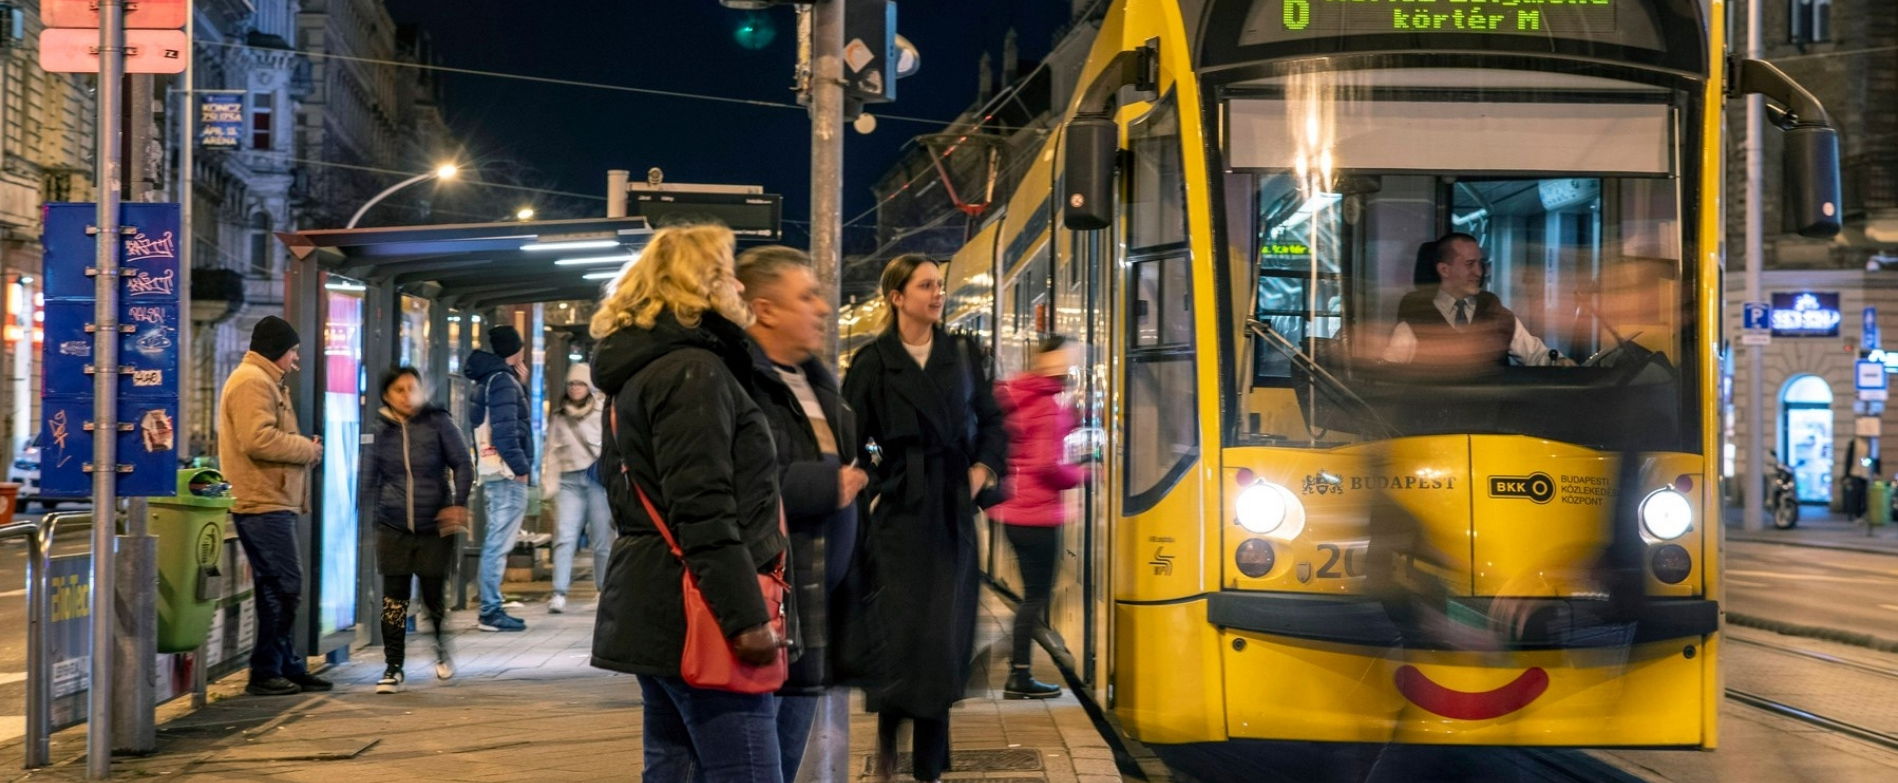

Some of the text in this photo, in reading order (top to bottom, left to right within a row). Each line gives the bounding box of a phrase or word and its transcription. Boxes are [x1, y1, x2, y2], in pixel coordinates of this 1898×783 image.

[1393, 7, 1539, 30] körtér M
[1350, 476, 1457, 490] BUDAPEST
[1560, 475, 1609, 486] BUDAPESTI
[1496, 482, 1527, 493] BKK
[1562, 496, 1604, 506] KÖZPONT
